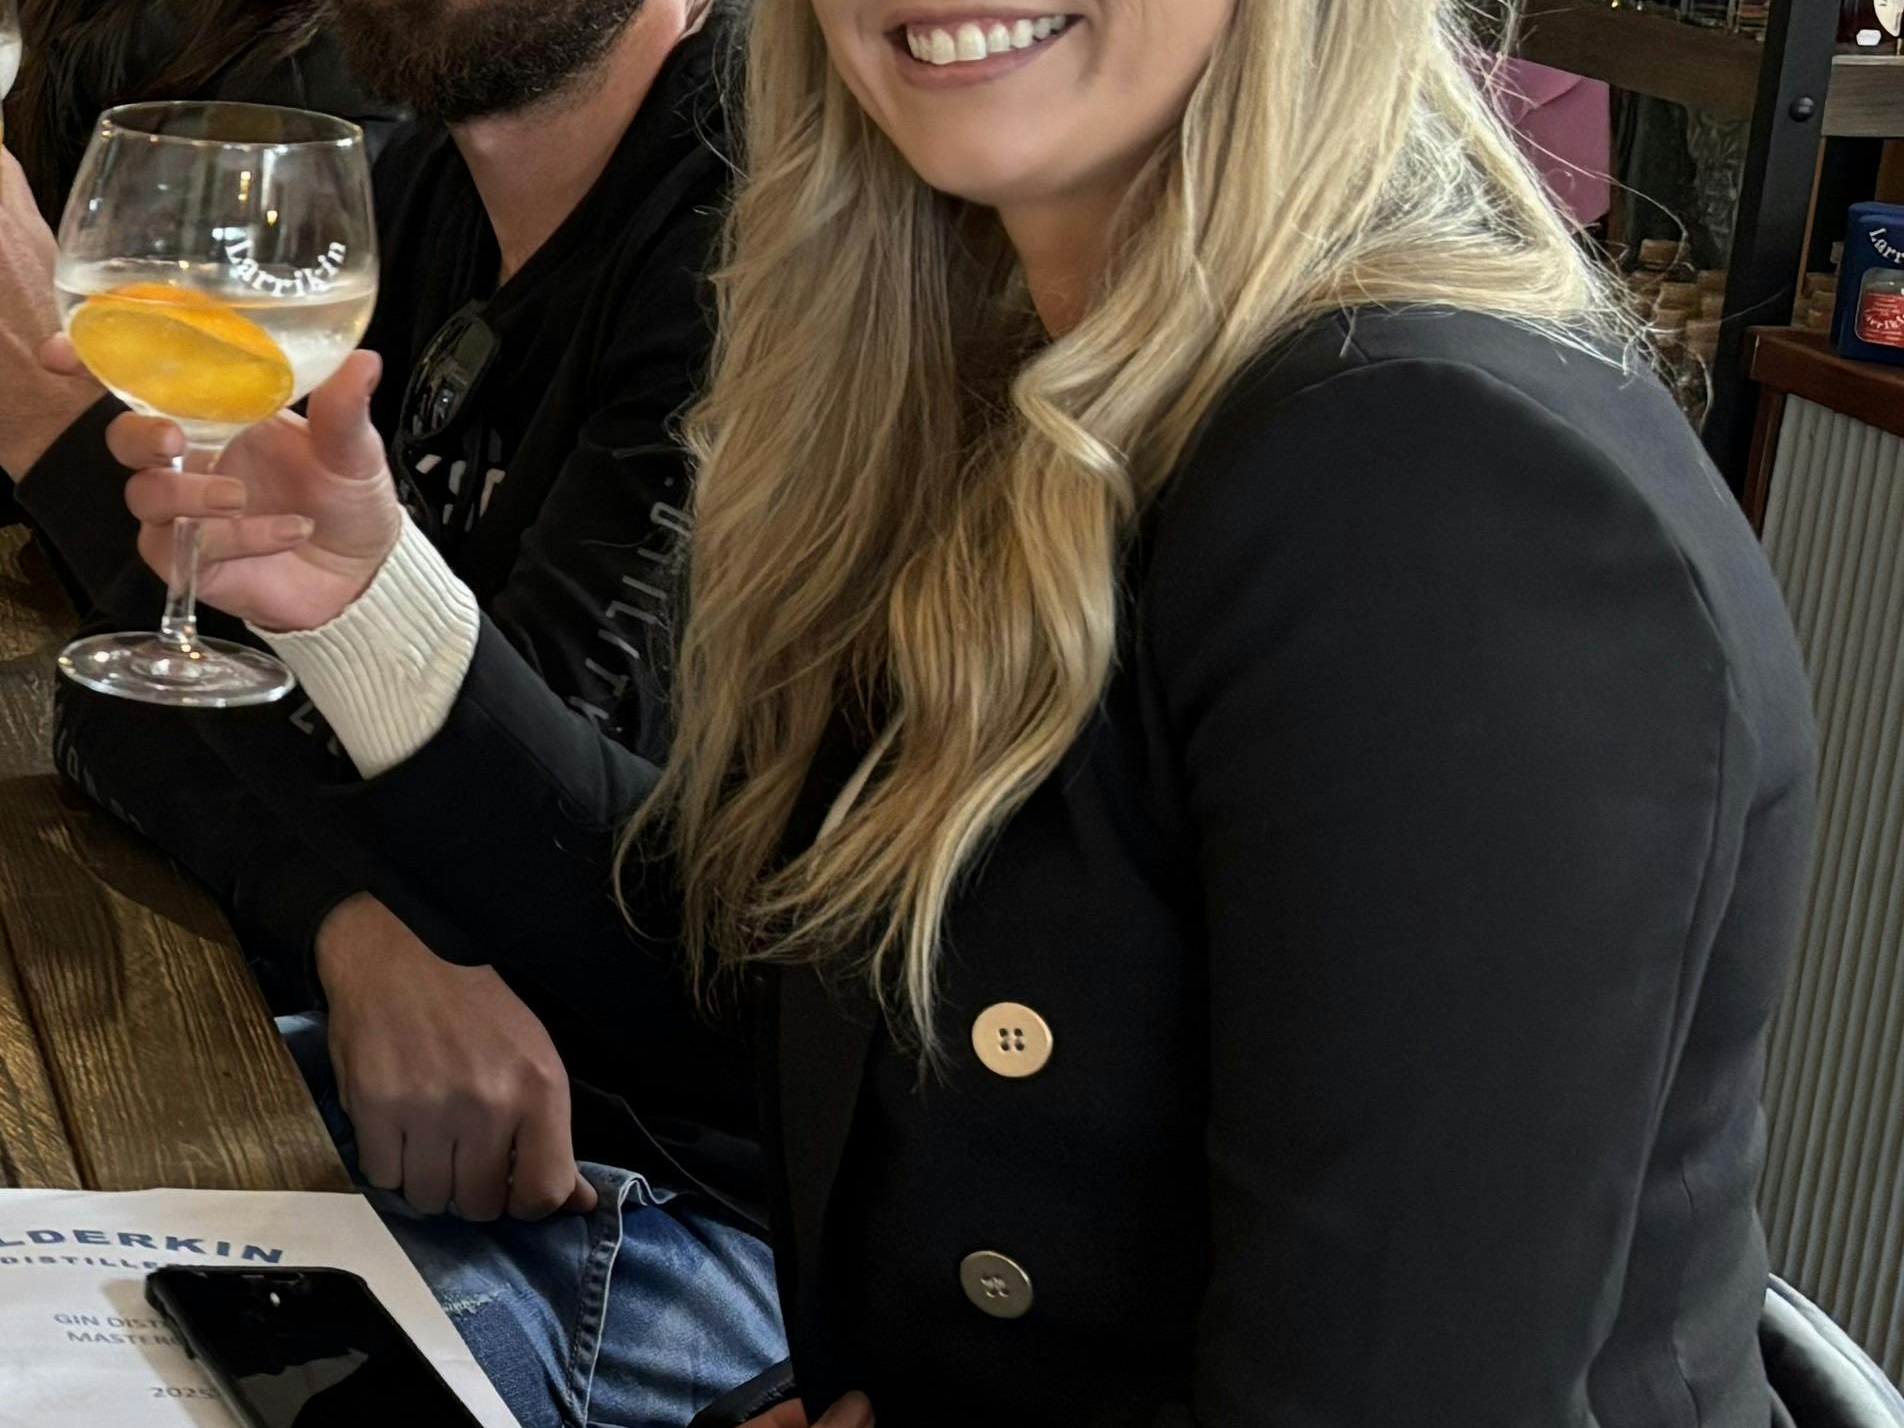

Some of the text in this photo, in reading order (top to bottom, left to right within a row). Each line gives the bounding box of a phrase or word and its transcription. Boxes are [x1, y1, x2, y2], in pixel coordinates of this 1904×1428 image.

[1869, 227, 1904, 264] Larr
[225, 239, 347, 297] Larrikin
[0, 1256, 159, 1270] DISTILLE
[54, 1313, 100, 1326] GIN
[150, 1387, 217, 1399] 2025
